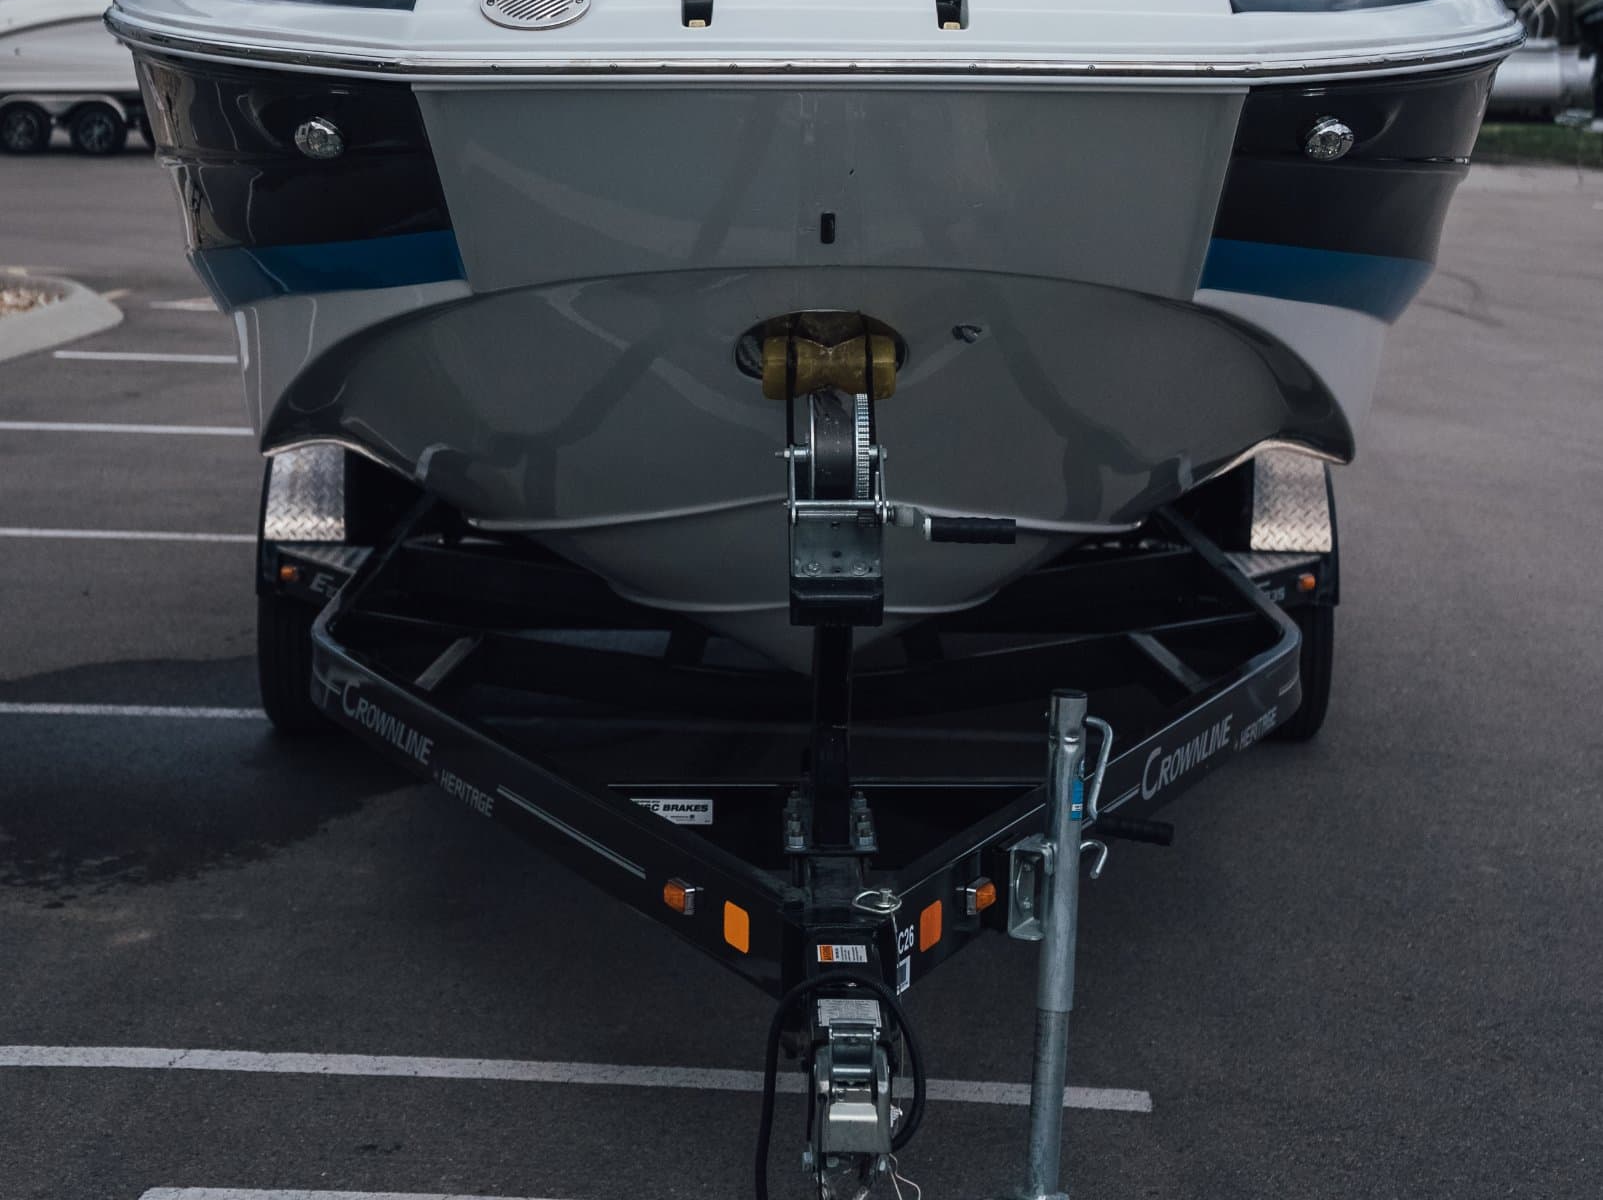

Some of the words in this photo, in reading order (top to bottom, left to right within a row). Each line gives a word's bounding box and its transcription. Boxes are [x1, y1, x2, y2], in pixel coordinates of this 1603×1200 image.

[343, 680, 433, 765] CROWNLINE
[440, 769, 494, 816] HERITAGE
[1141, 714, 1233, 800] CROWNLINE
[662, 804, 708, 812] BRAKES
